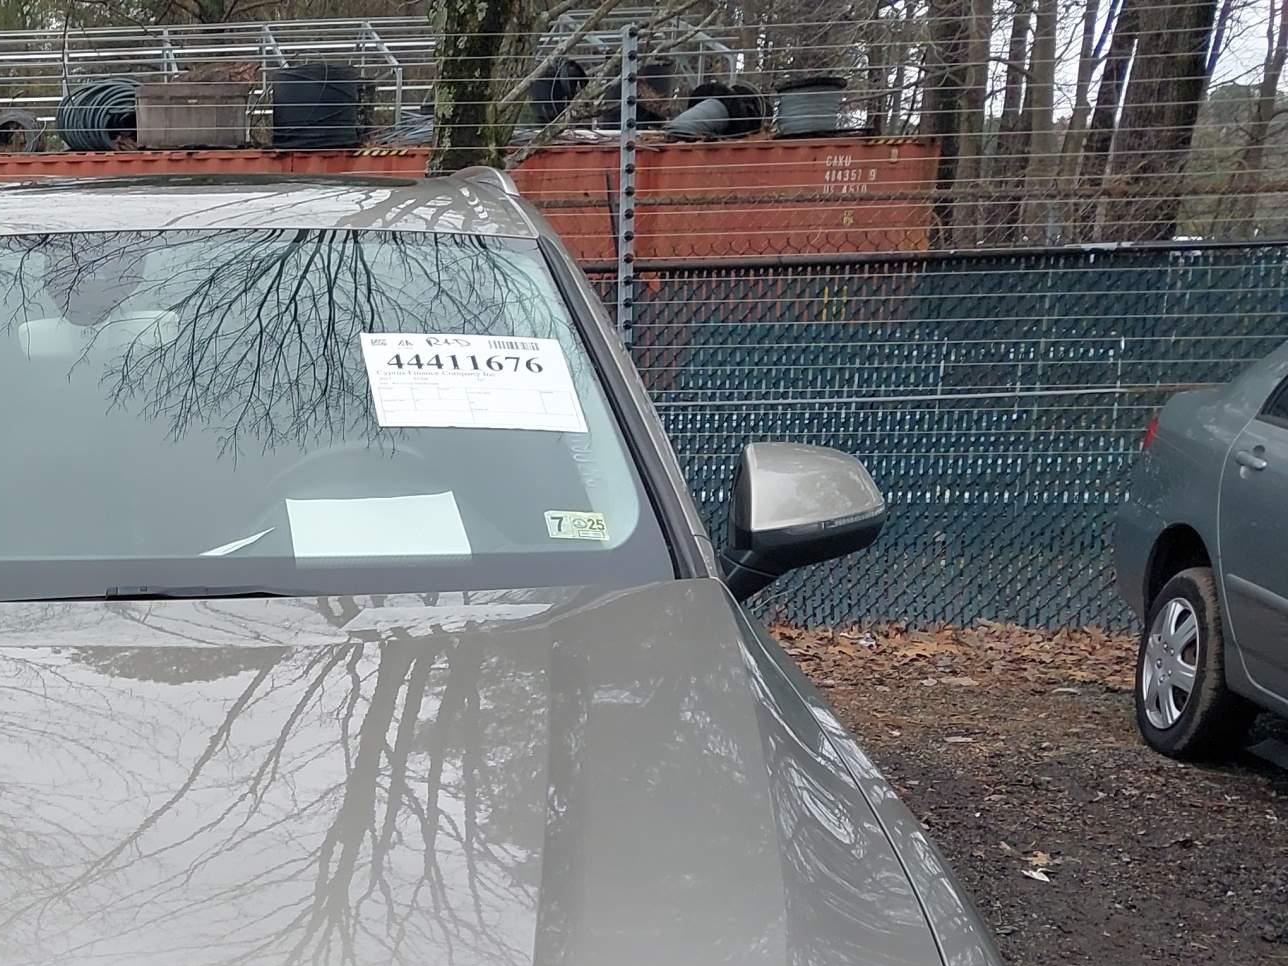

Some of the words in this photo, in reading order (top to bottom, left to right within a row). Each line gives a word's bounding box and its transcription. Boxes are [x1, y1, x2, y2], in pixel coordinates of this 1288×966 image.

[387, 353, 544, 375] 44411676
[550, 516, 563, 532] 7
[587, 518, 605, 531] 25
